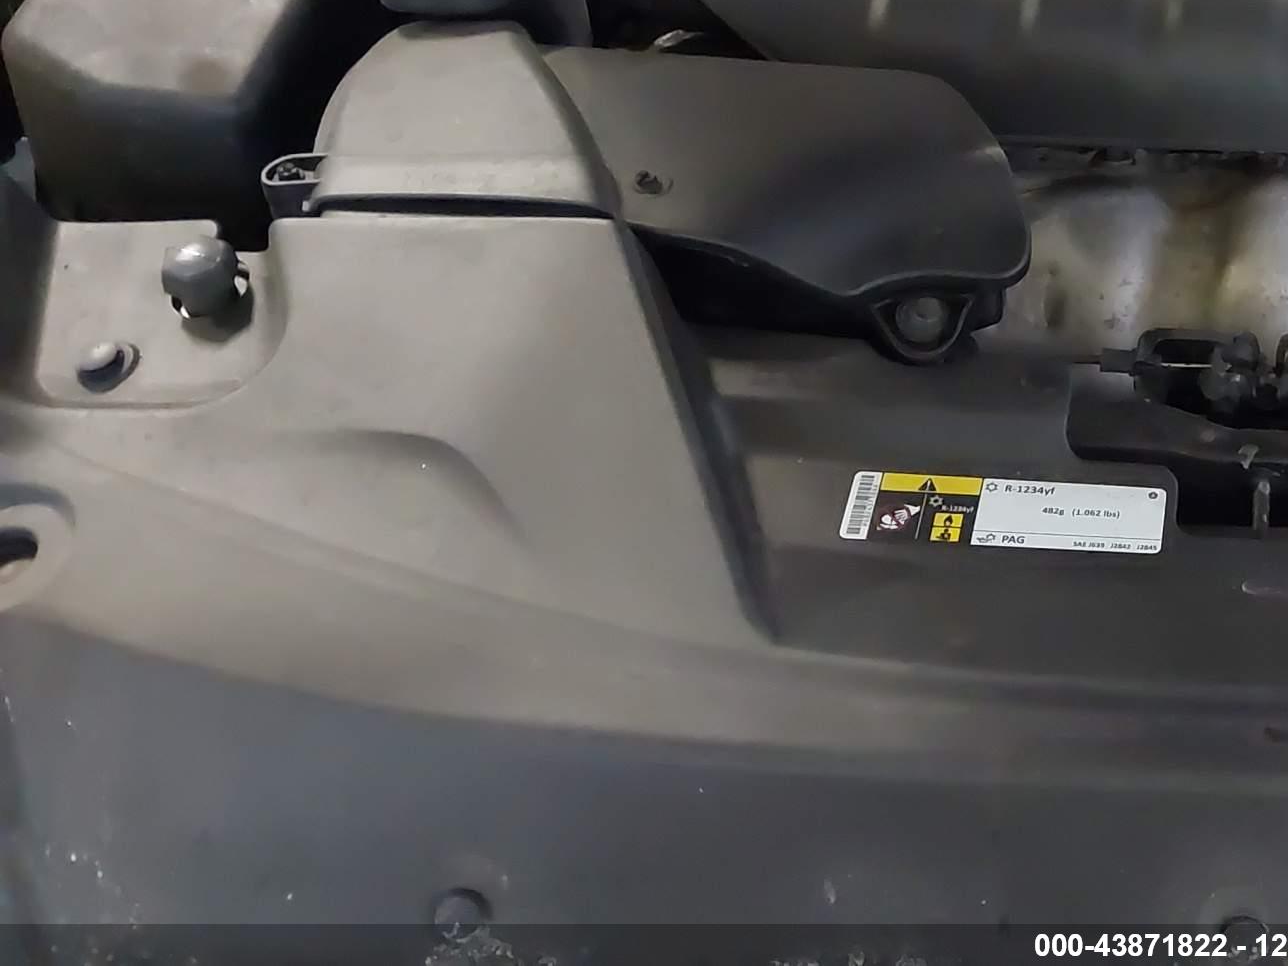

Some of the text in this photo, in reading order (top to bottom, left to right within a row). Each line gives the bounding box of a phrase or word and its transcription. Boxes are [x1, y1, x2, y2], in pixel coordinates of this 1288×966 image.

[1004, 484, 1056, 496] R-1234yf
[1042, 507, 1120, 519] 482g (1.062 lbs)
[1001, 534, 1025, 545] PAG
